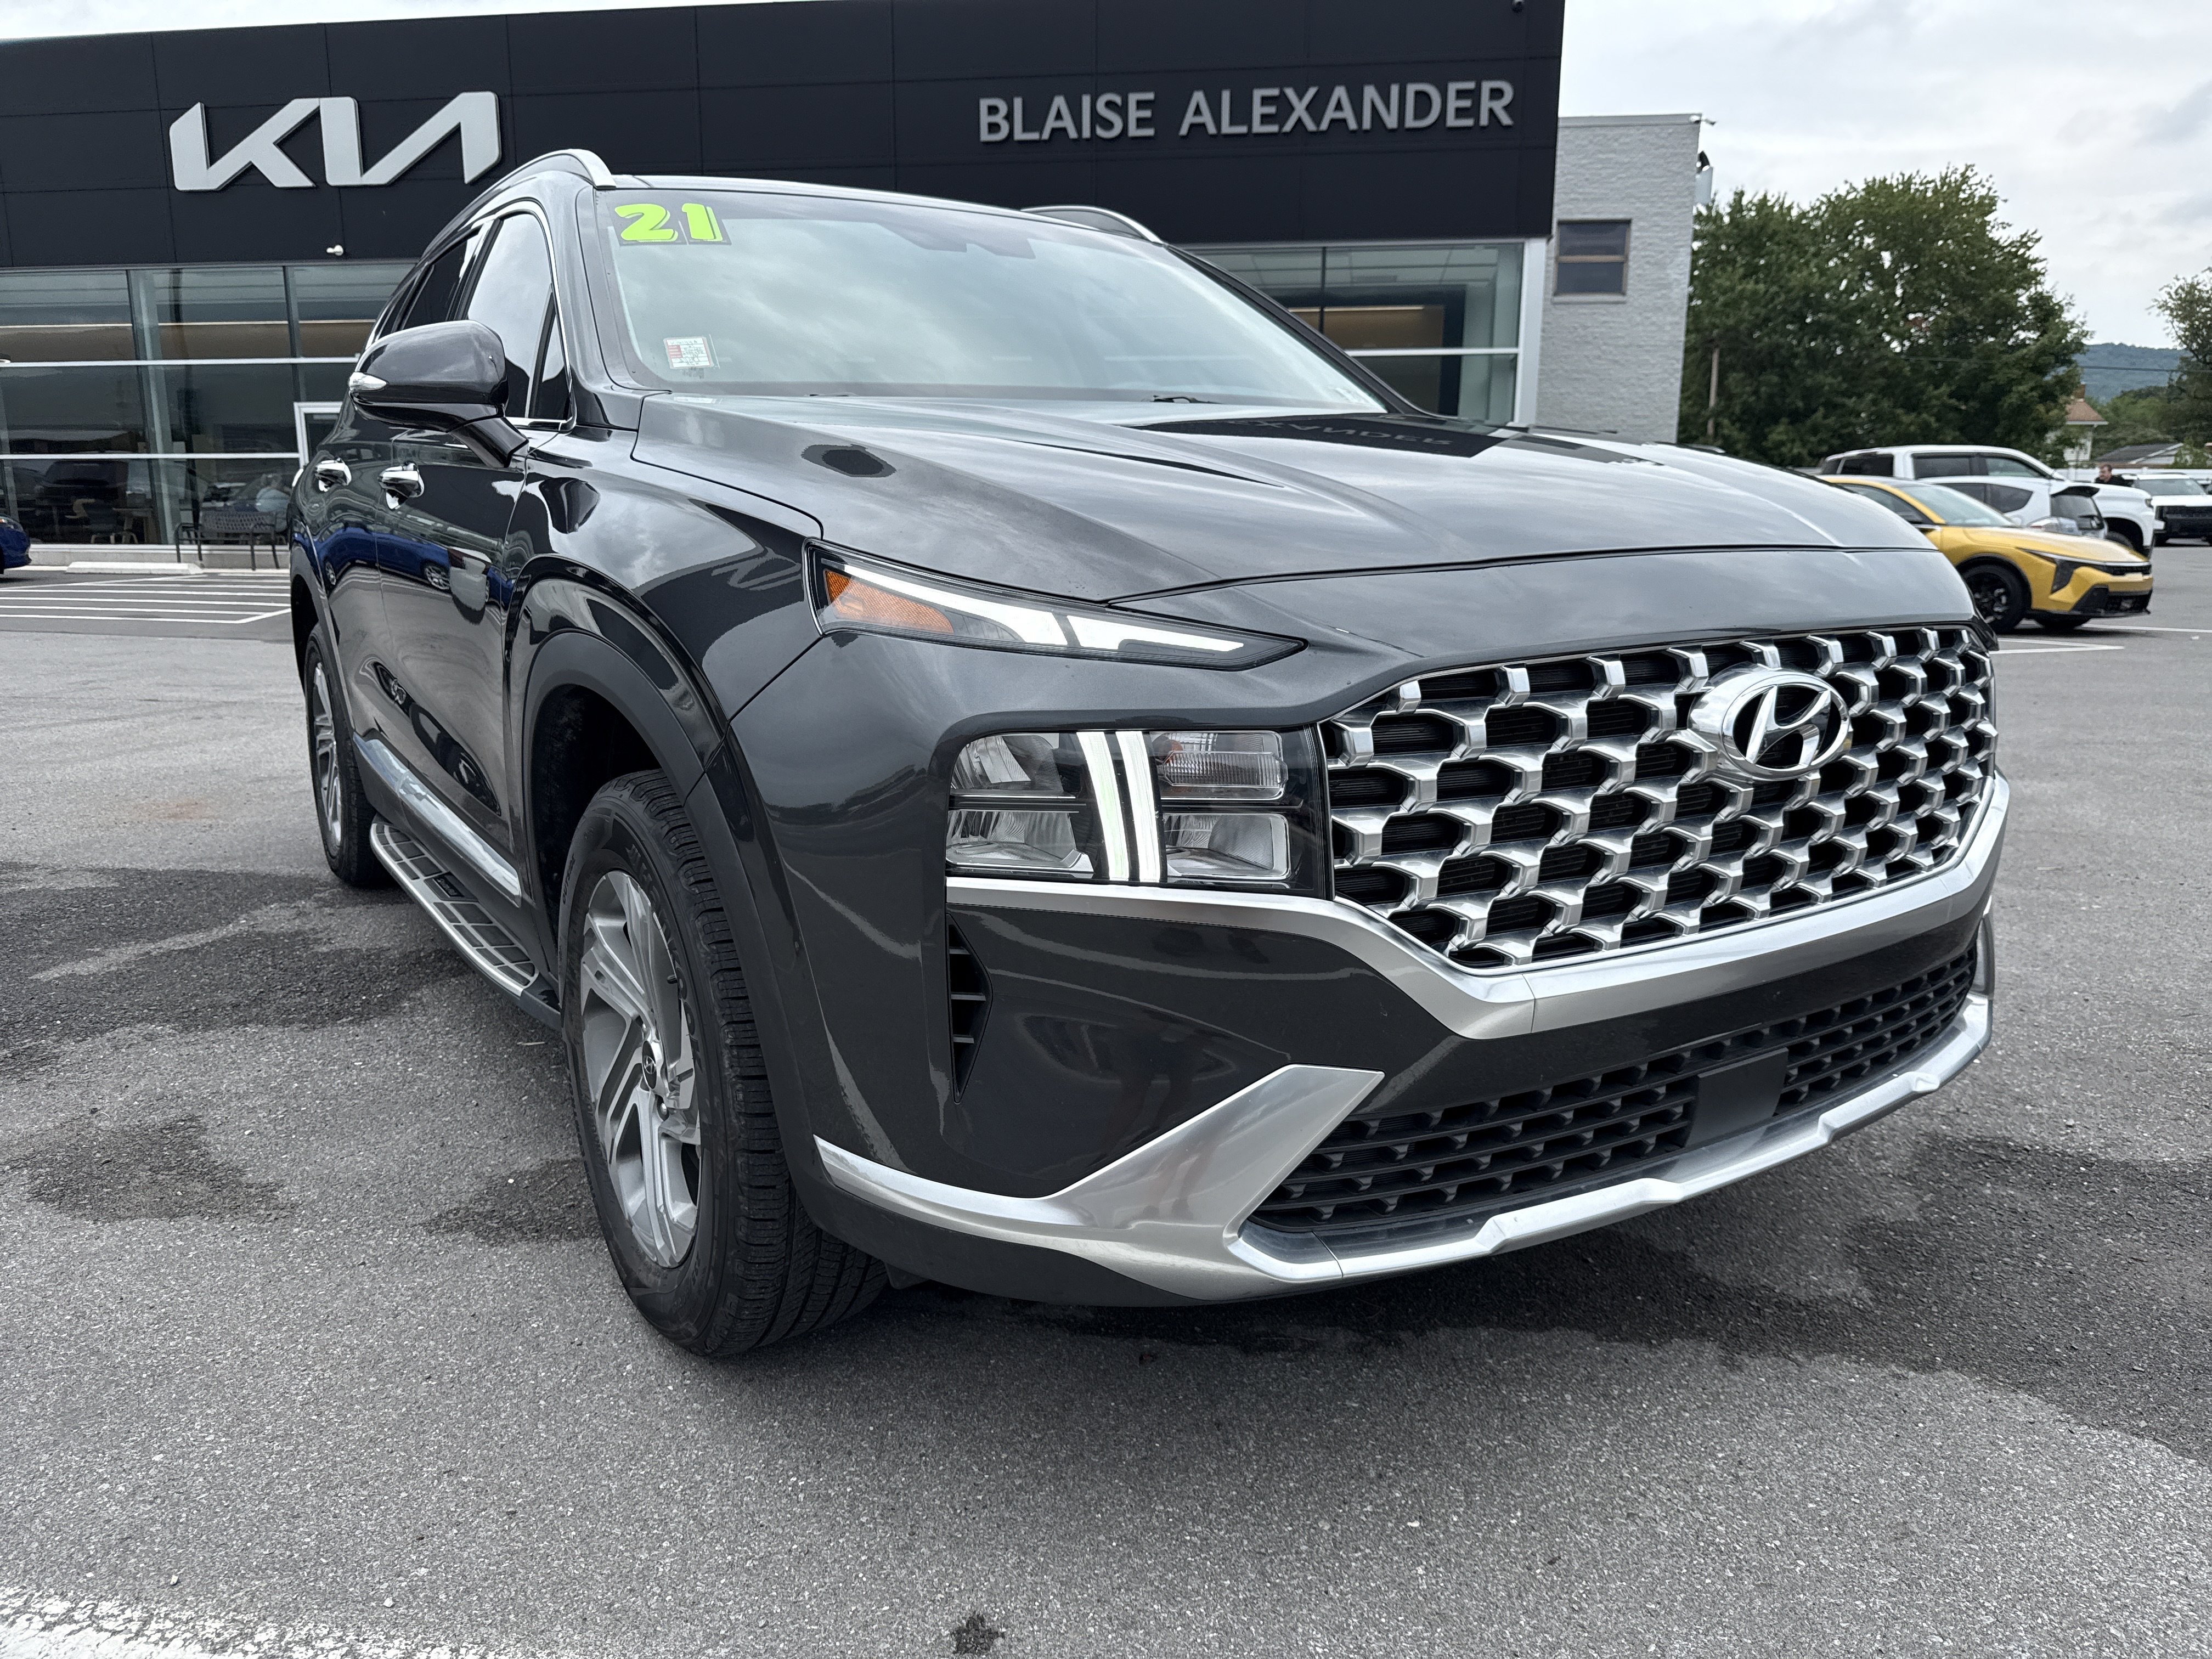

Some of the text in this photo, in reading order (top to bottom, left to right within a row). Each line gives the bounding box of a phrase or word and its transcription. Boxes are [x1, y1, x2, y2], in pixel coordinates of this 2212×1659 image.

[979, 80, 1514, 143] BLAISE ALEXANDER
[169, 91, 502, 192] KIA
[614, 202, 723, 242] 21
[562, 851, 575, 905] OUTSIDE
